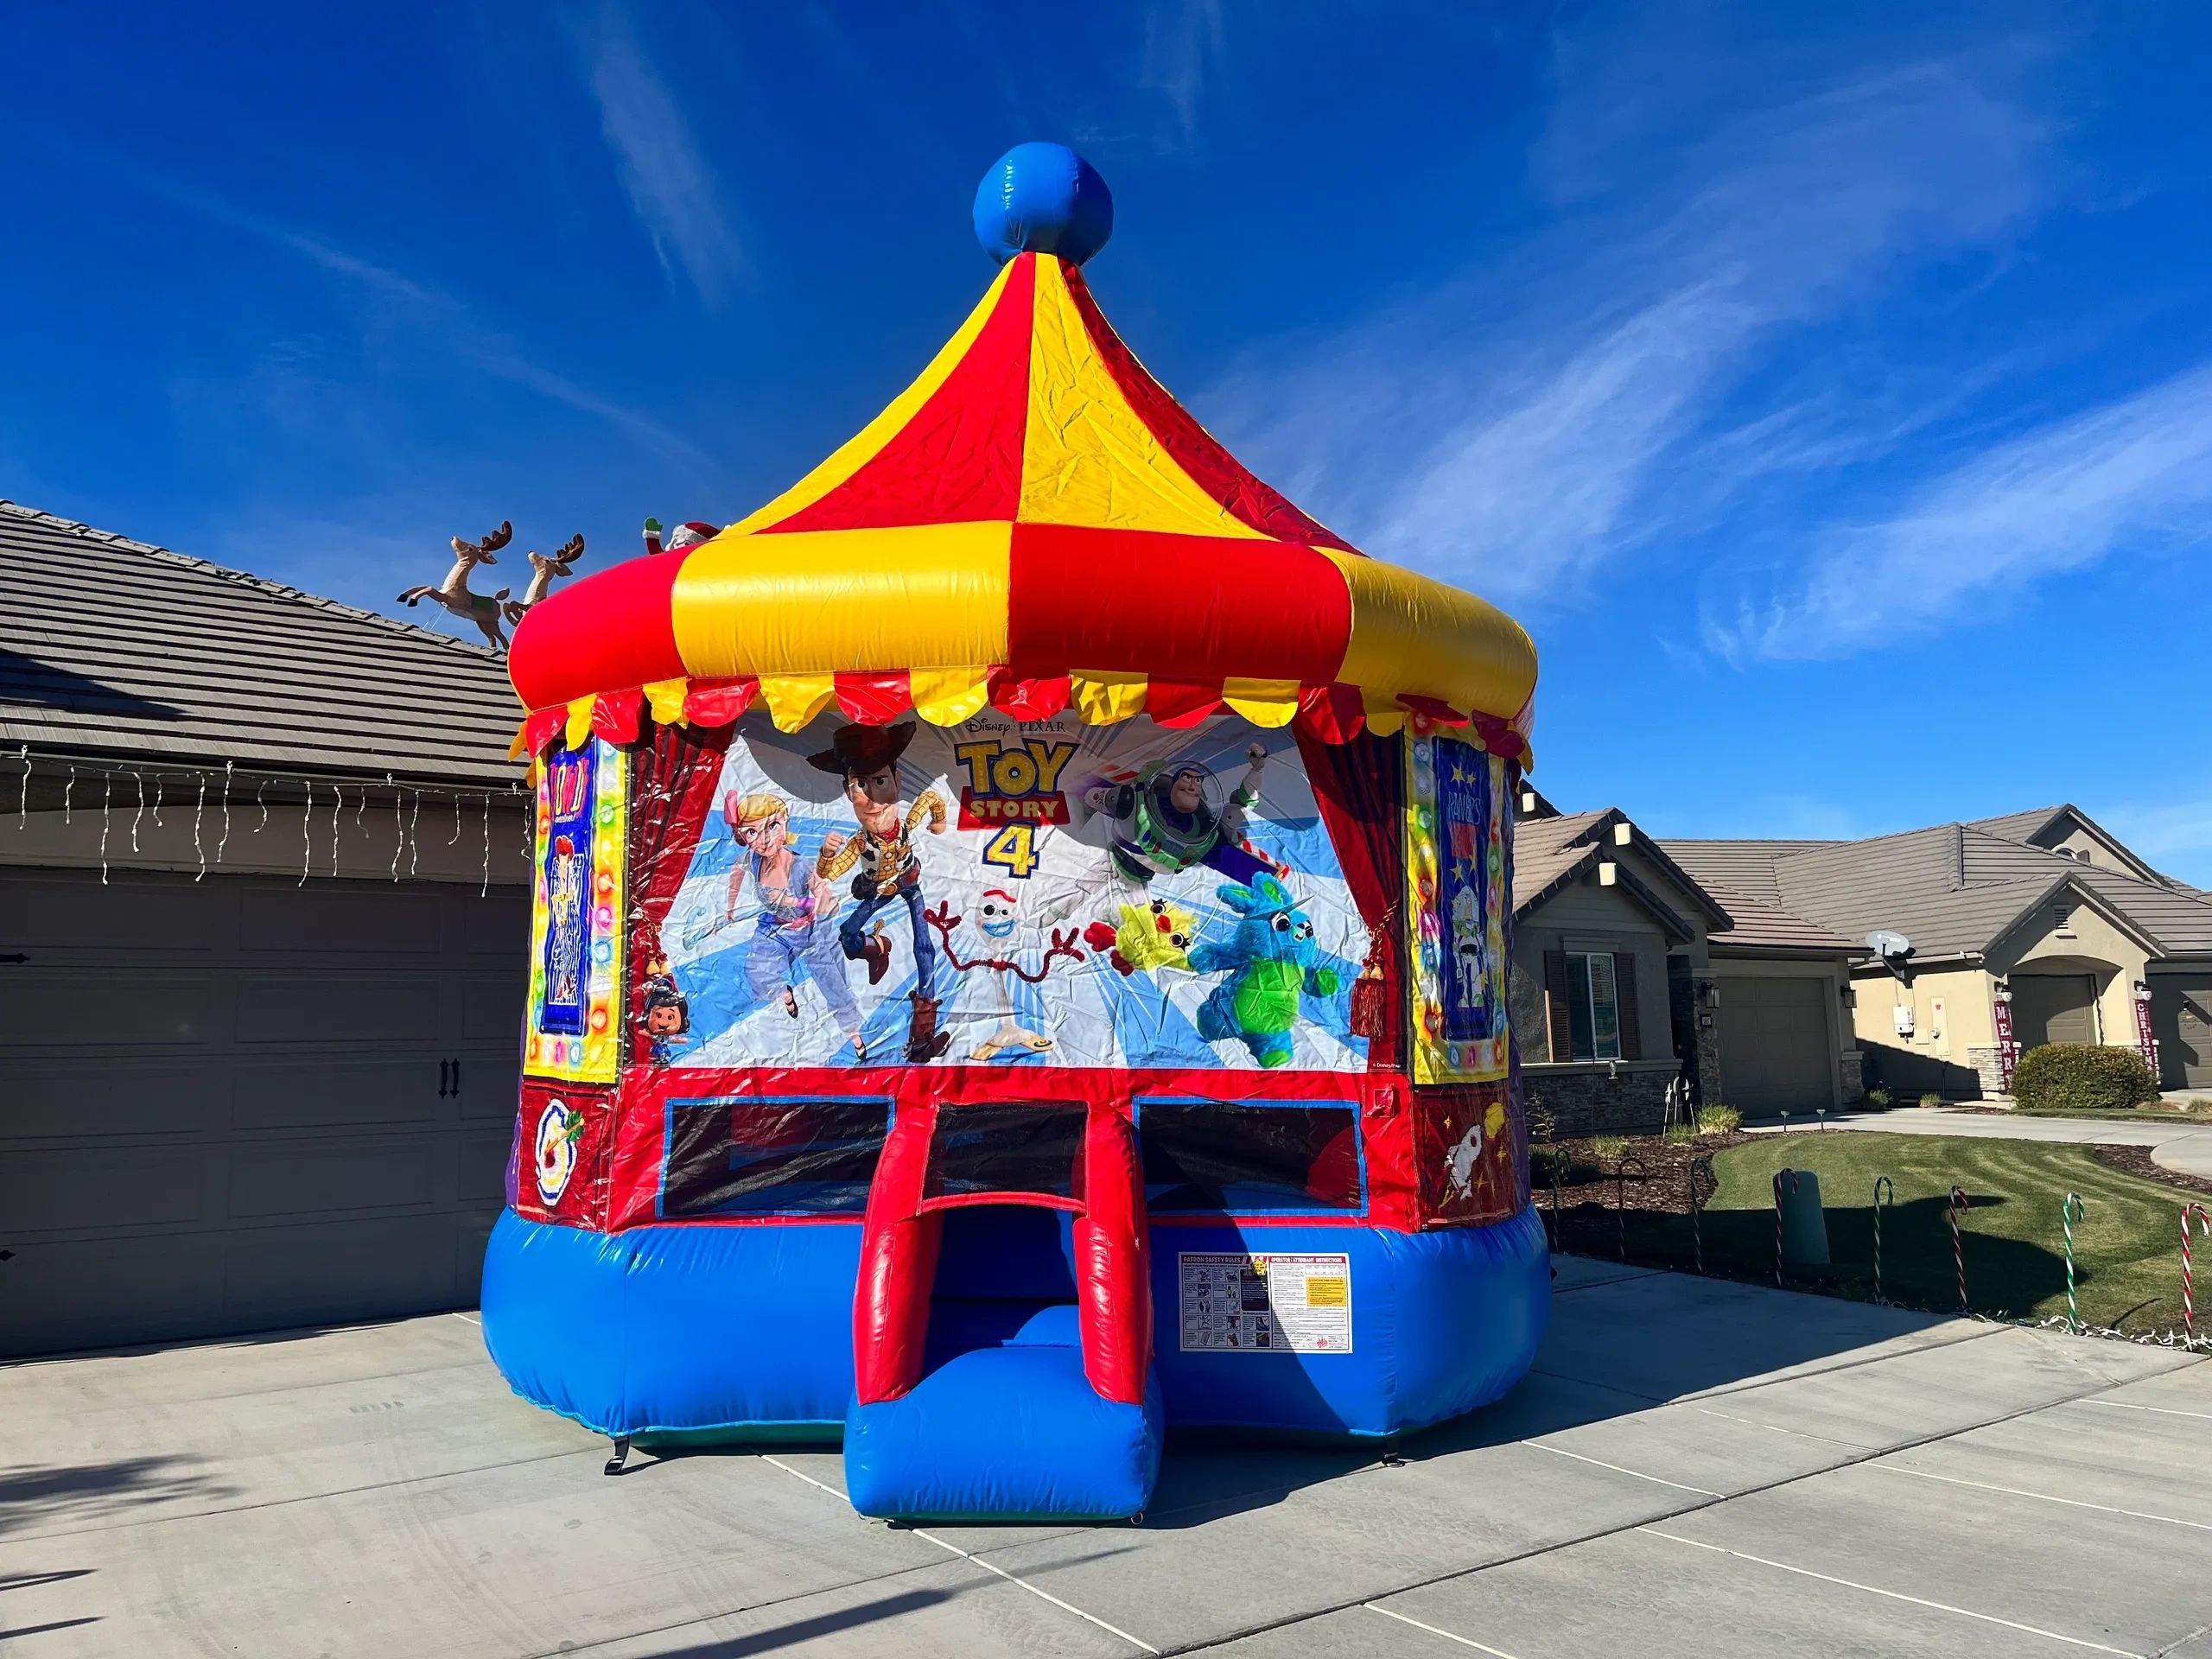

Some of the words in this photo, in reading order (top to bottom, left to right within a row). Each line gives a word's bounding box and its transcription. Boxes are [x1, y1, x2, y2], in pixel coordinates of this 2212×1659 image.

[1019, 721, 1065, 732] PIXAR
[954, 738, 1080, 799] TOY
[969, 800, 1060, 818] STORY
[982, 820, 1039, 880] 4
